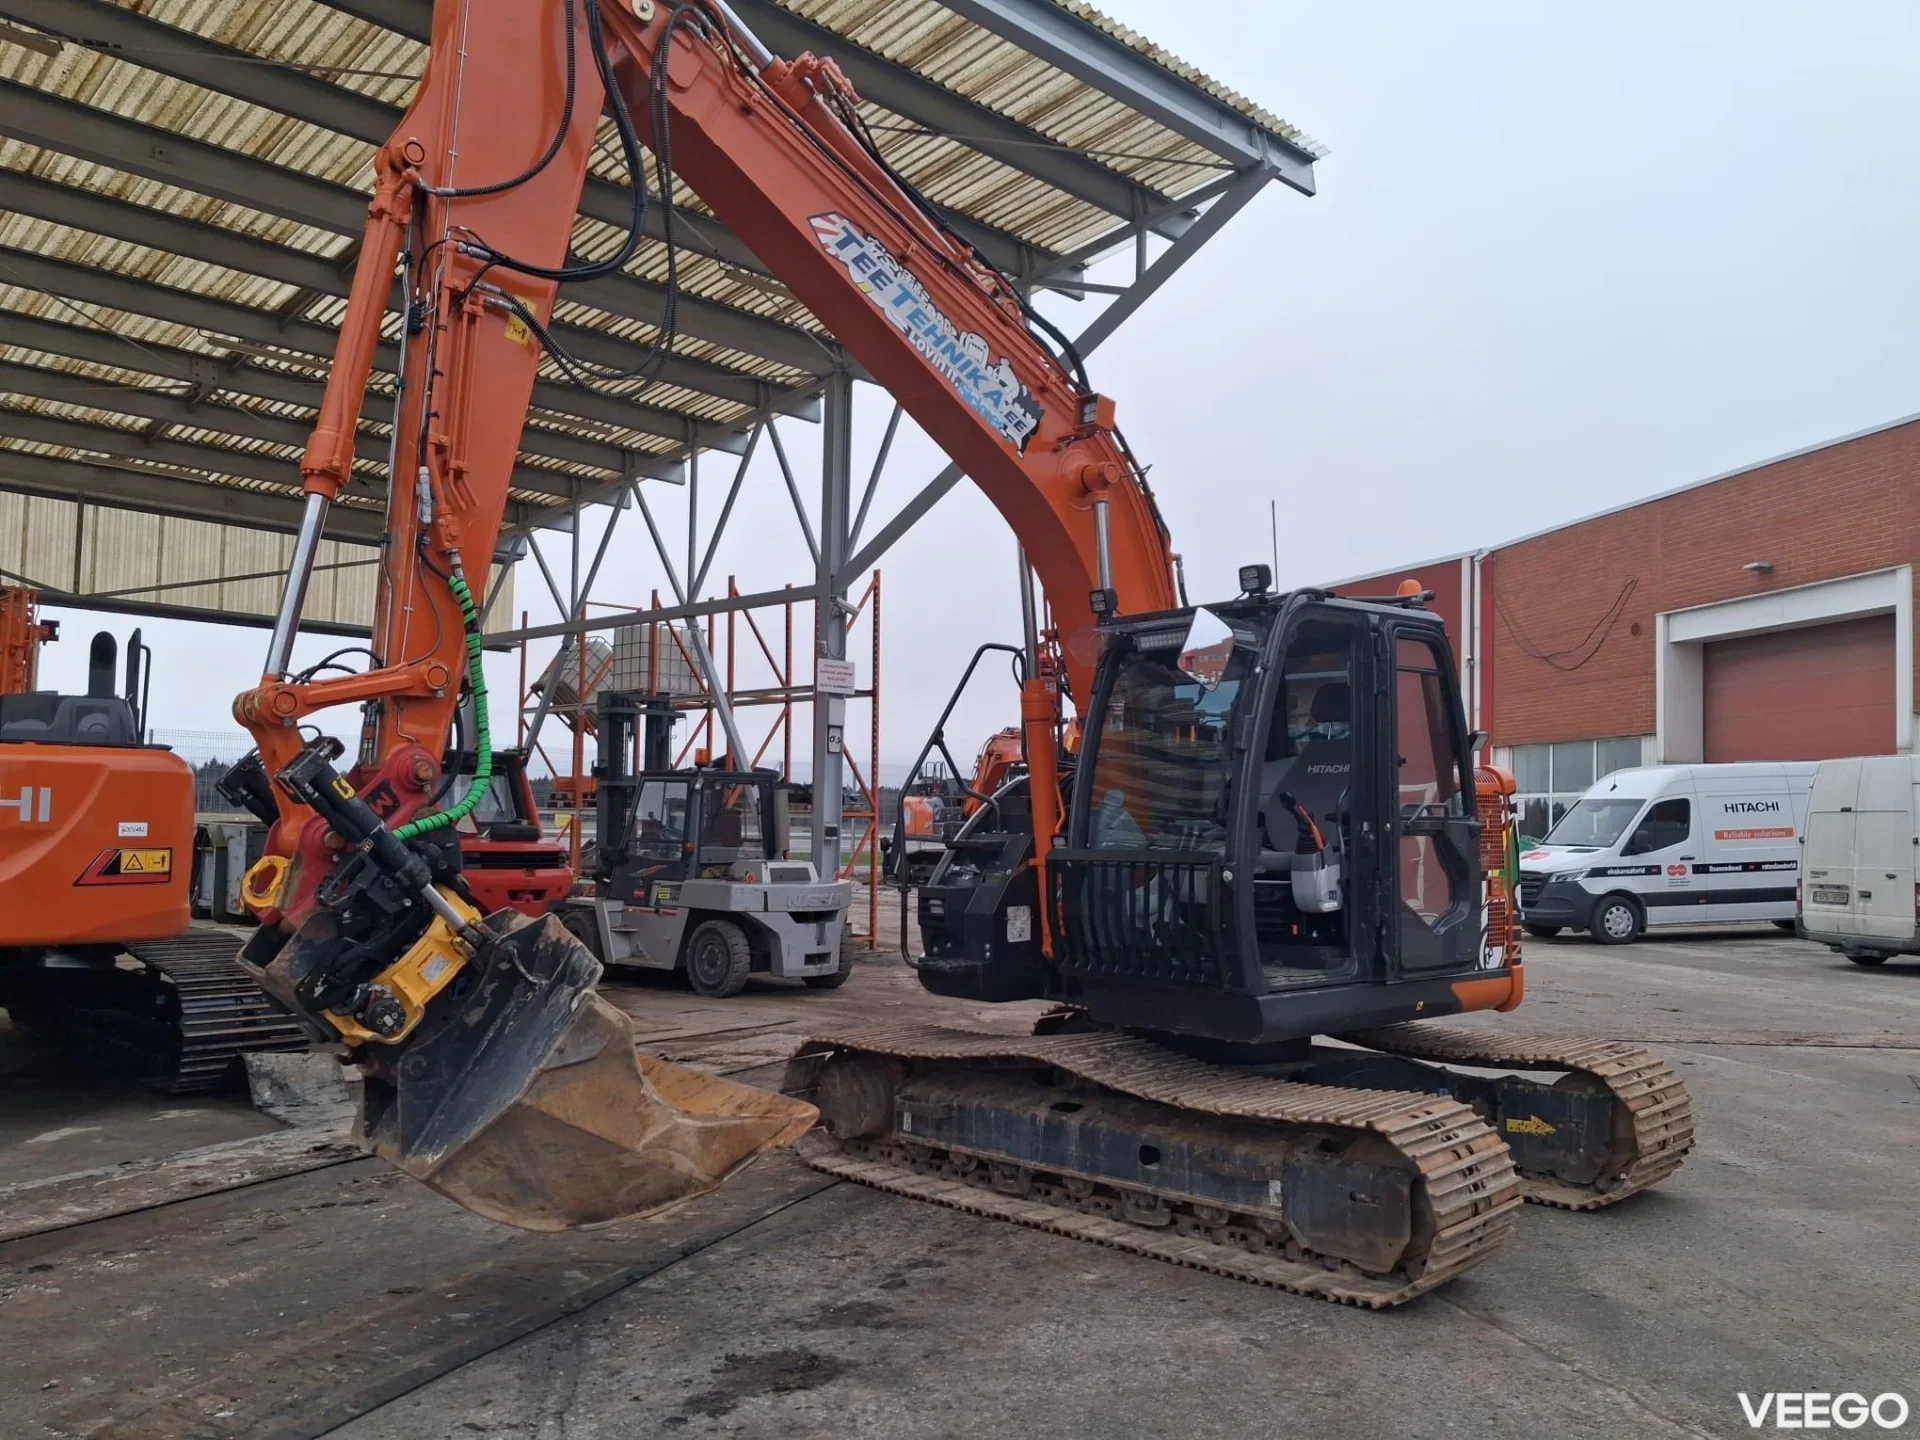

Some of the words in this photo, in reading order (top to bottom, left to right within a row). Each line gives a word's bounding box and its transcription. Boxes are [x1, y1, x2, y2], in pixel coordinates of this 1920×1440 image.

[834, 225, 893, 292] TEE
[1307, 764, 1350, 773] HITACHI
[1724, 802, 1779, 813] HITACHI
[1723, 831, 1752, 839] Reliable
[1754, 829, 1786, 837] solutions
